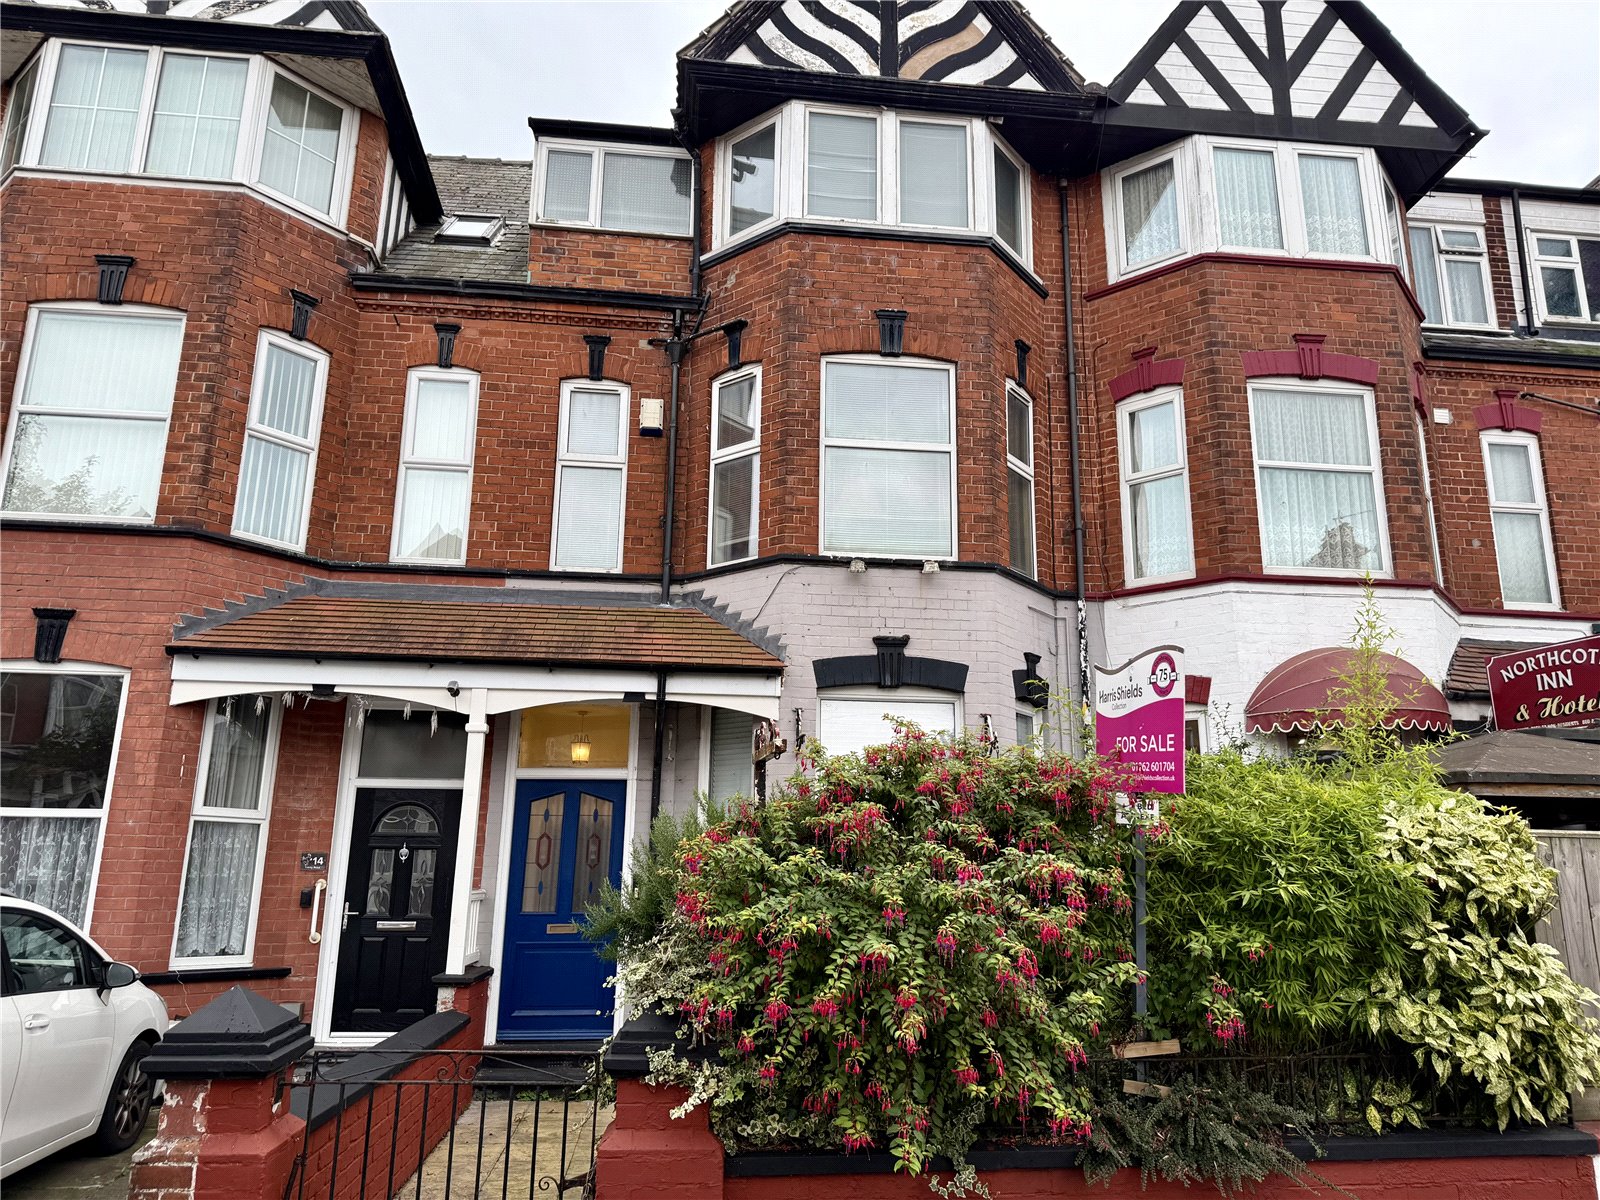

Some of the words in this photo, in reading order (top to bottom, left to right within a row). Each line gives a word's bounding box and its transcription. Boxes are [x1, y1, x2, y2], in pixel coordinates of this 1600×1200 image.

[1500, 648, 1600, 683] NORTHCOT
[1159, 668, 1168, 681] 75
[1536, 669, 1573, 691] INN
[1111, 703, 1127, 711] Collection
[1516, 704, 1530, 721] &
[1116, 735, 1137, 753] FOR
[1140, 733, 1175, 753] SALE
[1151, 761, 1175, 772] 601704
[312, 856, 324, 866] 14
